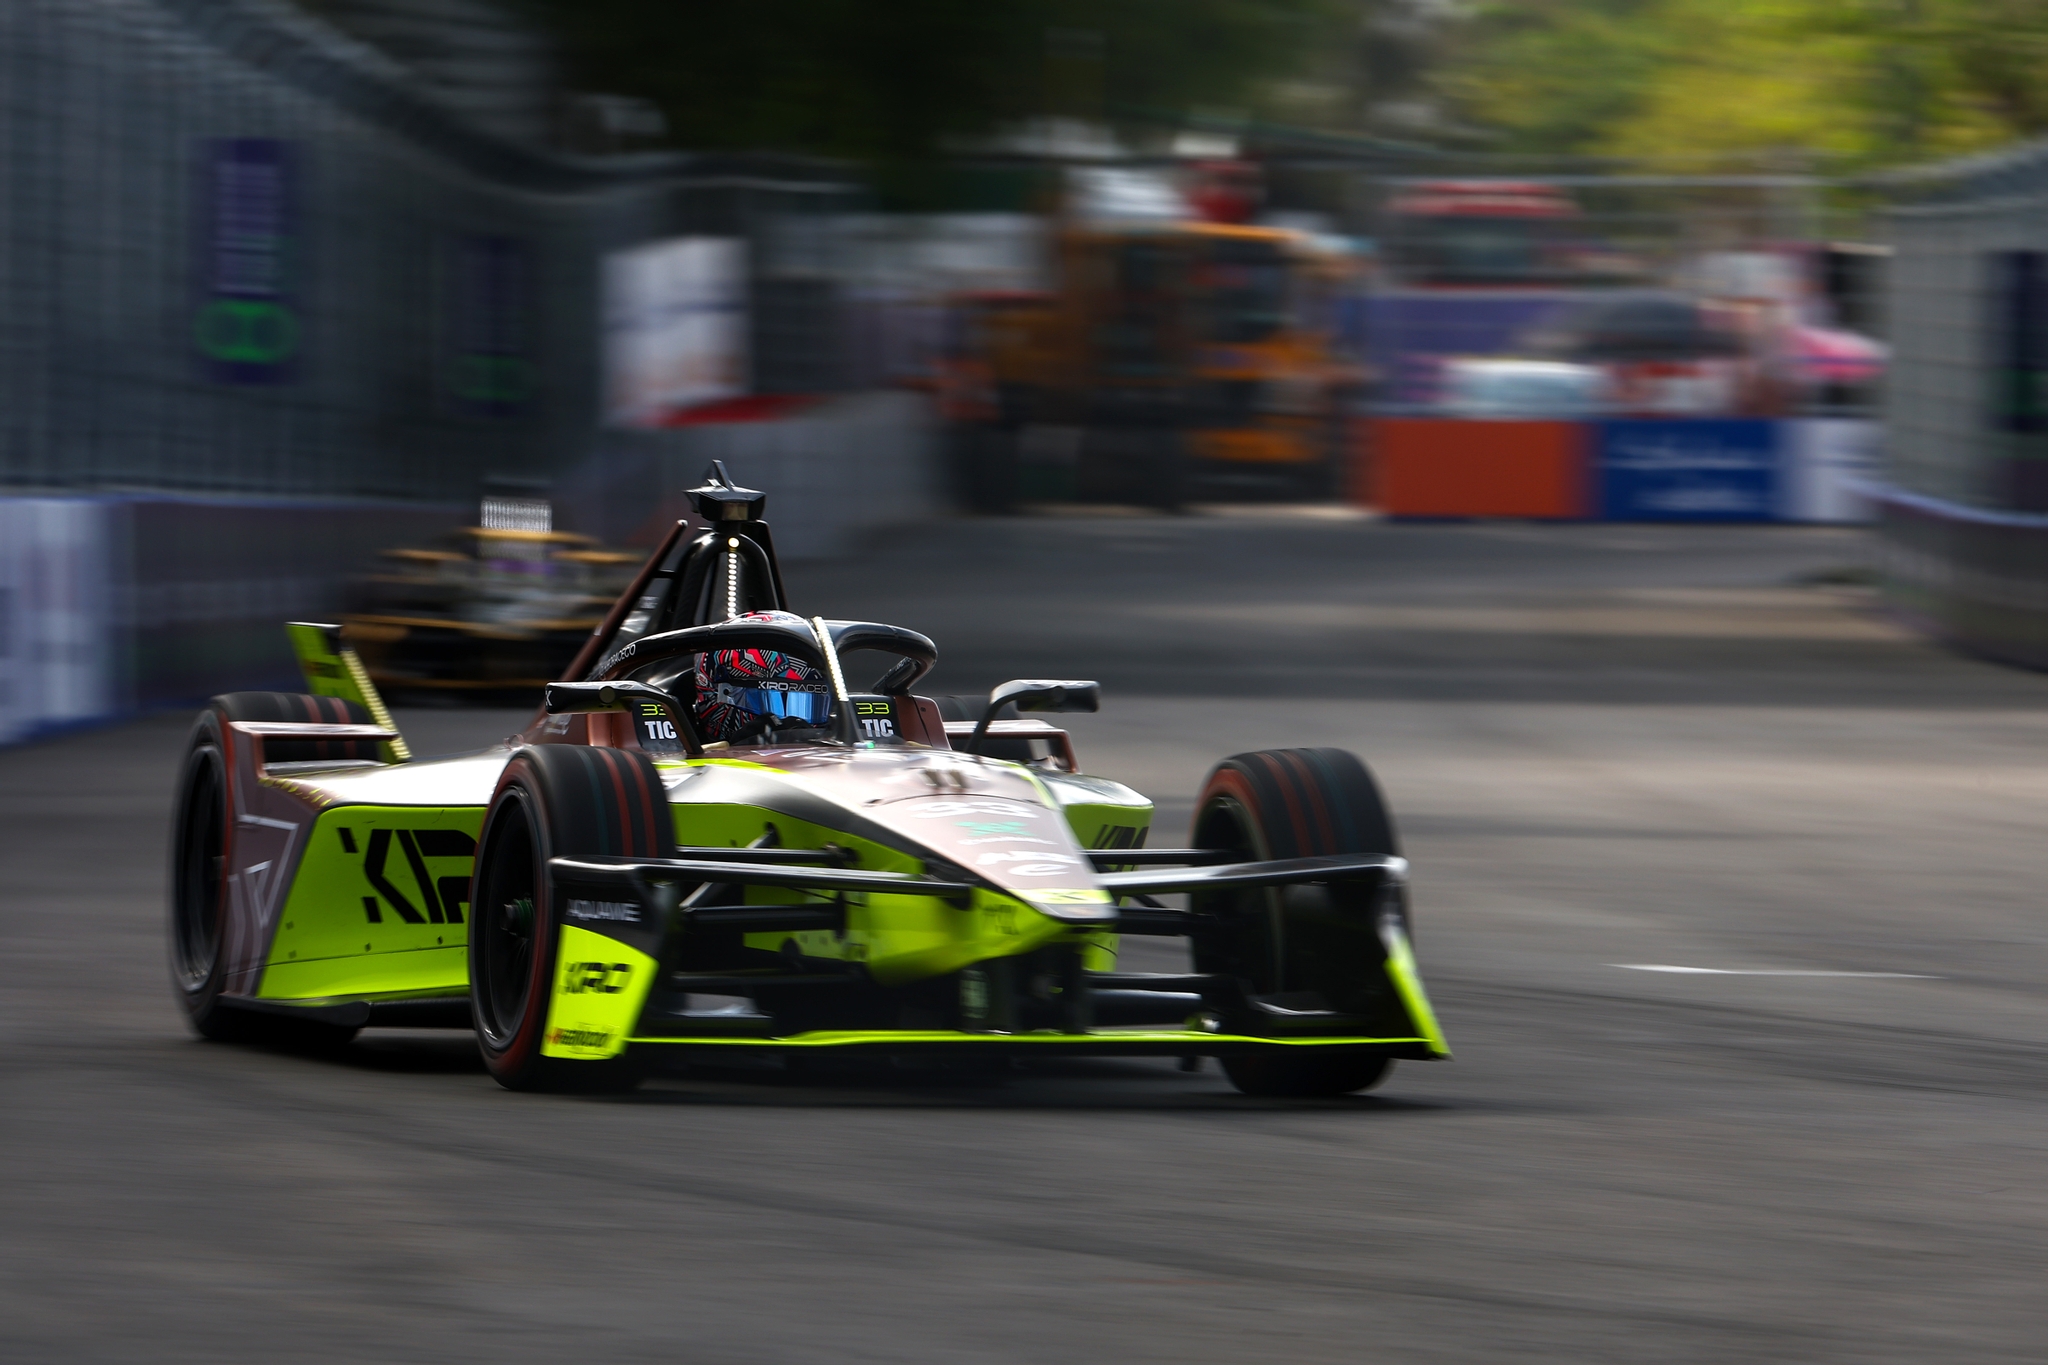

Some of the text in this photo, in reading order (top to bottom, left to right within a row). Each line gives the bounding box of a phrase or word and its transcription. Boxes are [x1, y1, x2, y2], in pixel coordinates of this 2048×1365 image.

[855, 702, 890, 715] 33
[644, 720, 678, 740] TIC
[861, 718, 895, 738] TIC
